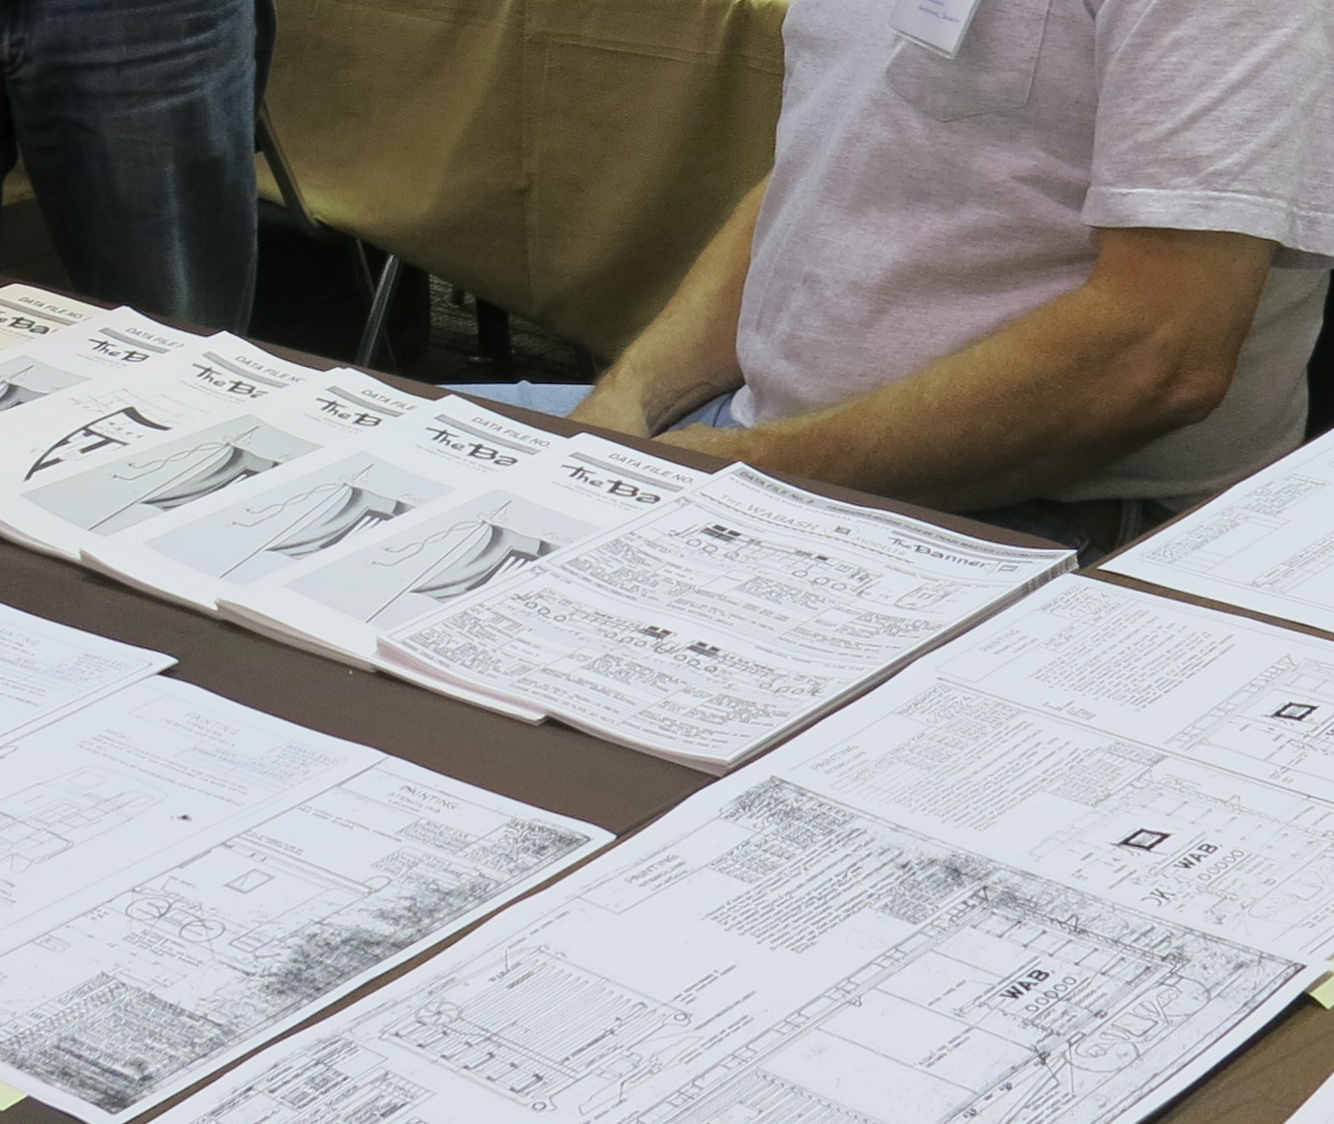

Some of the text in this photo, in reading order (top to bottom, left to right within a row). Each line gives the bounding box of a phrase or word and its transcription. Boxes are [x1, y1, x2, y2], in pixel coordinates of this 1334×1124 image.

[18, 295, 44, 309] DATA
[43, 303, 67, 315] FILE
[88, 338, 118, 358] The
[124, 326, 177, 349] DATA FILE
[192, 363, 224, 383] The
[235, 355, 264, 373] DATA
[261, 365, 289, 380] FILE
[315, 396, 349, 419] The
[361, 388, 415, 411] DATA FILE
[425, 426, 465, 451] The
[470, 416, 504, 434] DATA
[501, 427, 533, 442] FILE
[561, 464, 603, 489] The
[608, 452, 643, 469] DATA
[641, 462, 675, 477] FILE
[746, 504, 820, 532] WABASH
[913, 543, 988, 570] Banner
